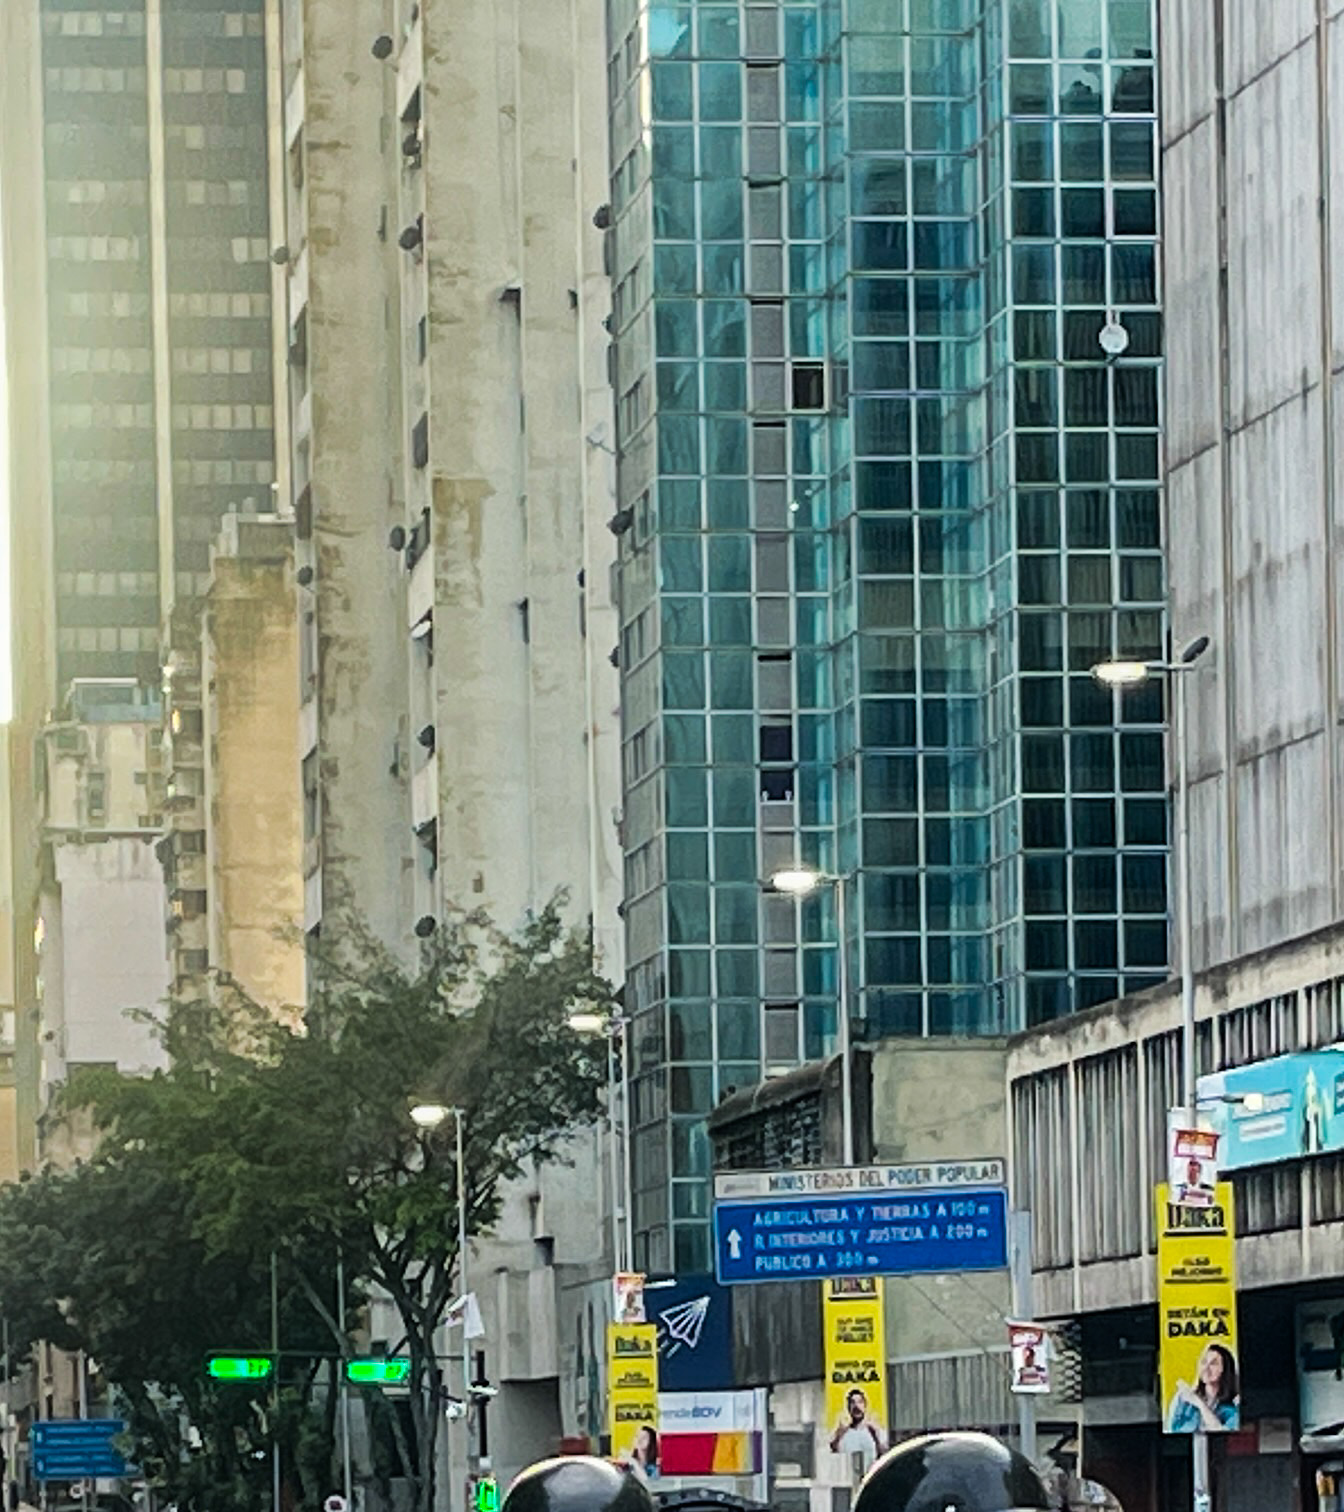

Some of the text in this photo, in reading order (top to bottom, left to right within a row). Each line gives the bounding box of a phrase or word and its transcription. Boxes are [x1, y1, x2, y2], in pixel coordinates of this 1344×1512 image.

[768, 1163, 1000, 1192] MINISTERIOS DEL PODER POPULAR
[753, 1207, 850, 1227] AGRICULTURA
[855, 1206, 865, 1222] Y
[871, 1202, 931, 1221] TIERRAS
[936, 1202, 948, 1217] A
[850, 1229, 860, 1244] Y
[865, 1226, 924, 1244] JUSTICIA
[929, 1224, 940, 1239] A
[816, 1253, 828, 1269] A
[1168, 1320, 1231, 1338] DAKA
[832, 1370, 881, 1384] DAKA
